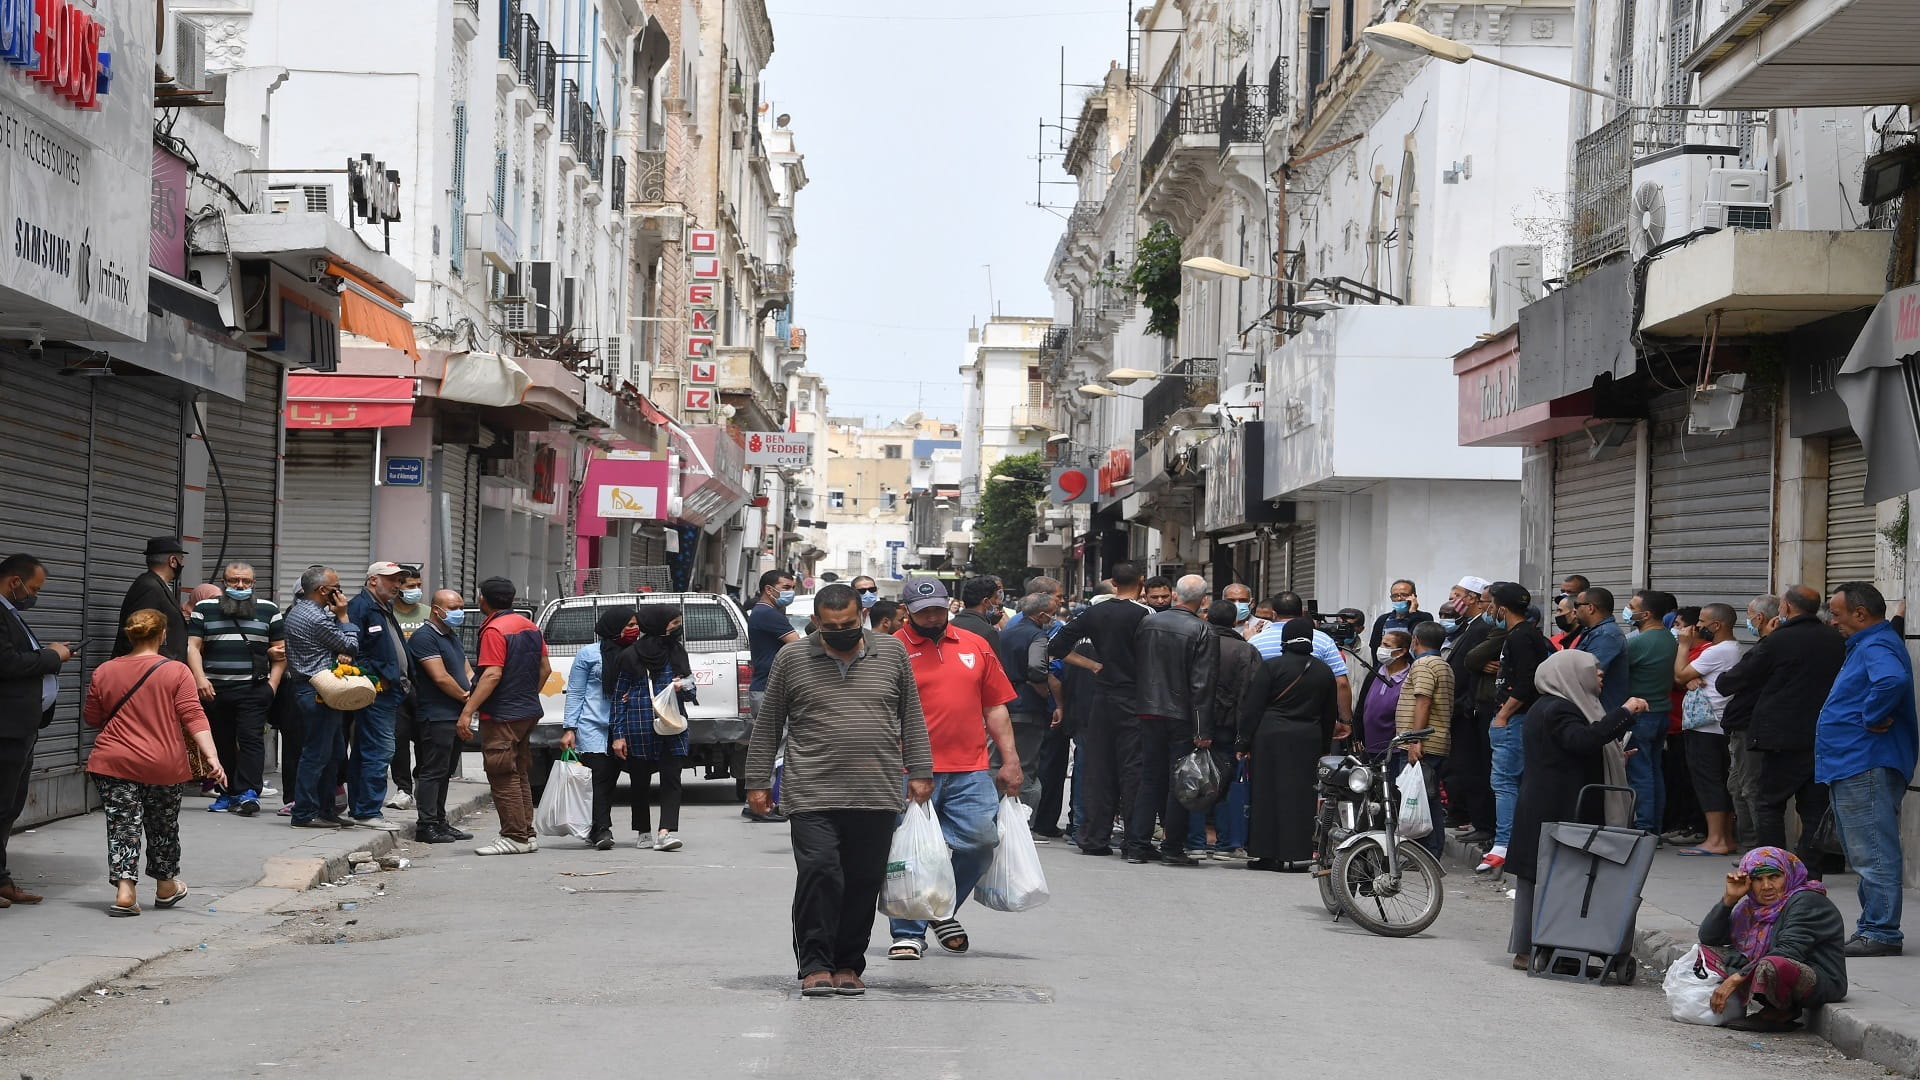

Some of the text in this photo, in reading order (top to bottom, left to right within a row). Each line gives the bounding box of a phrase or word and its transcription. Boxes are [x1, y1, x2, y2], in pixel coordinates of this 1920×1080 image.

[6, 115, 18, 151] ET
[23, 126, 80, 186] ACCESSOIRES
[15, 217, 71, 278] SAMSUNG
[98, 258, 130, 305] Infinix
[1480, 368, 1502, 422] Tout
[765, 434, 785, 444] BEN
[765, 444, 806, 454] YEDDER
